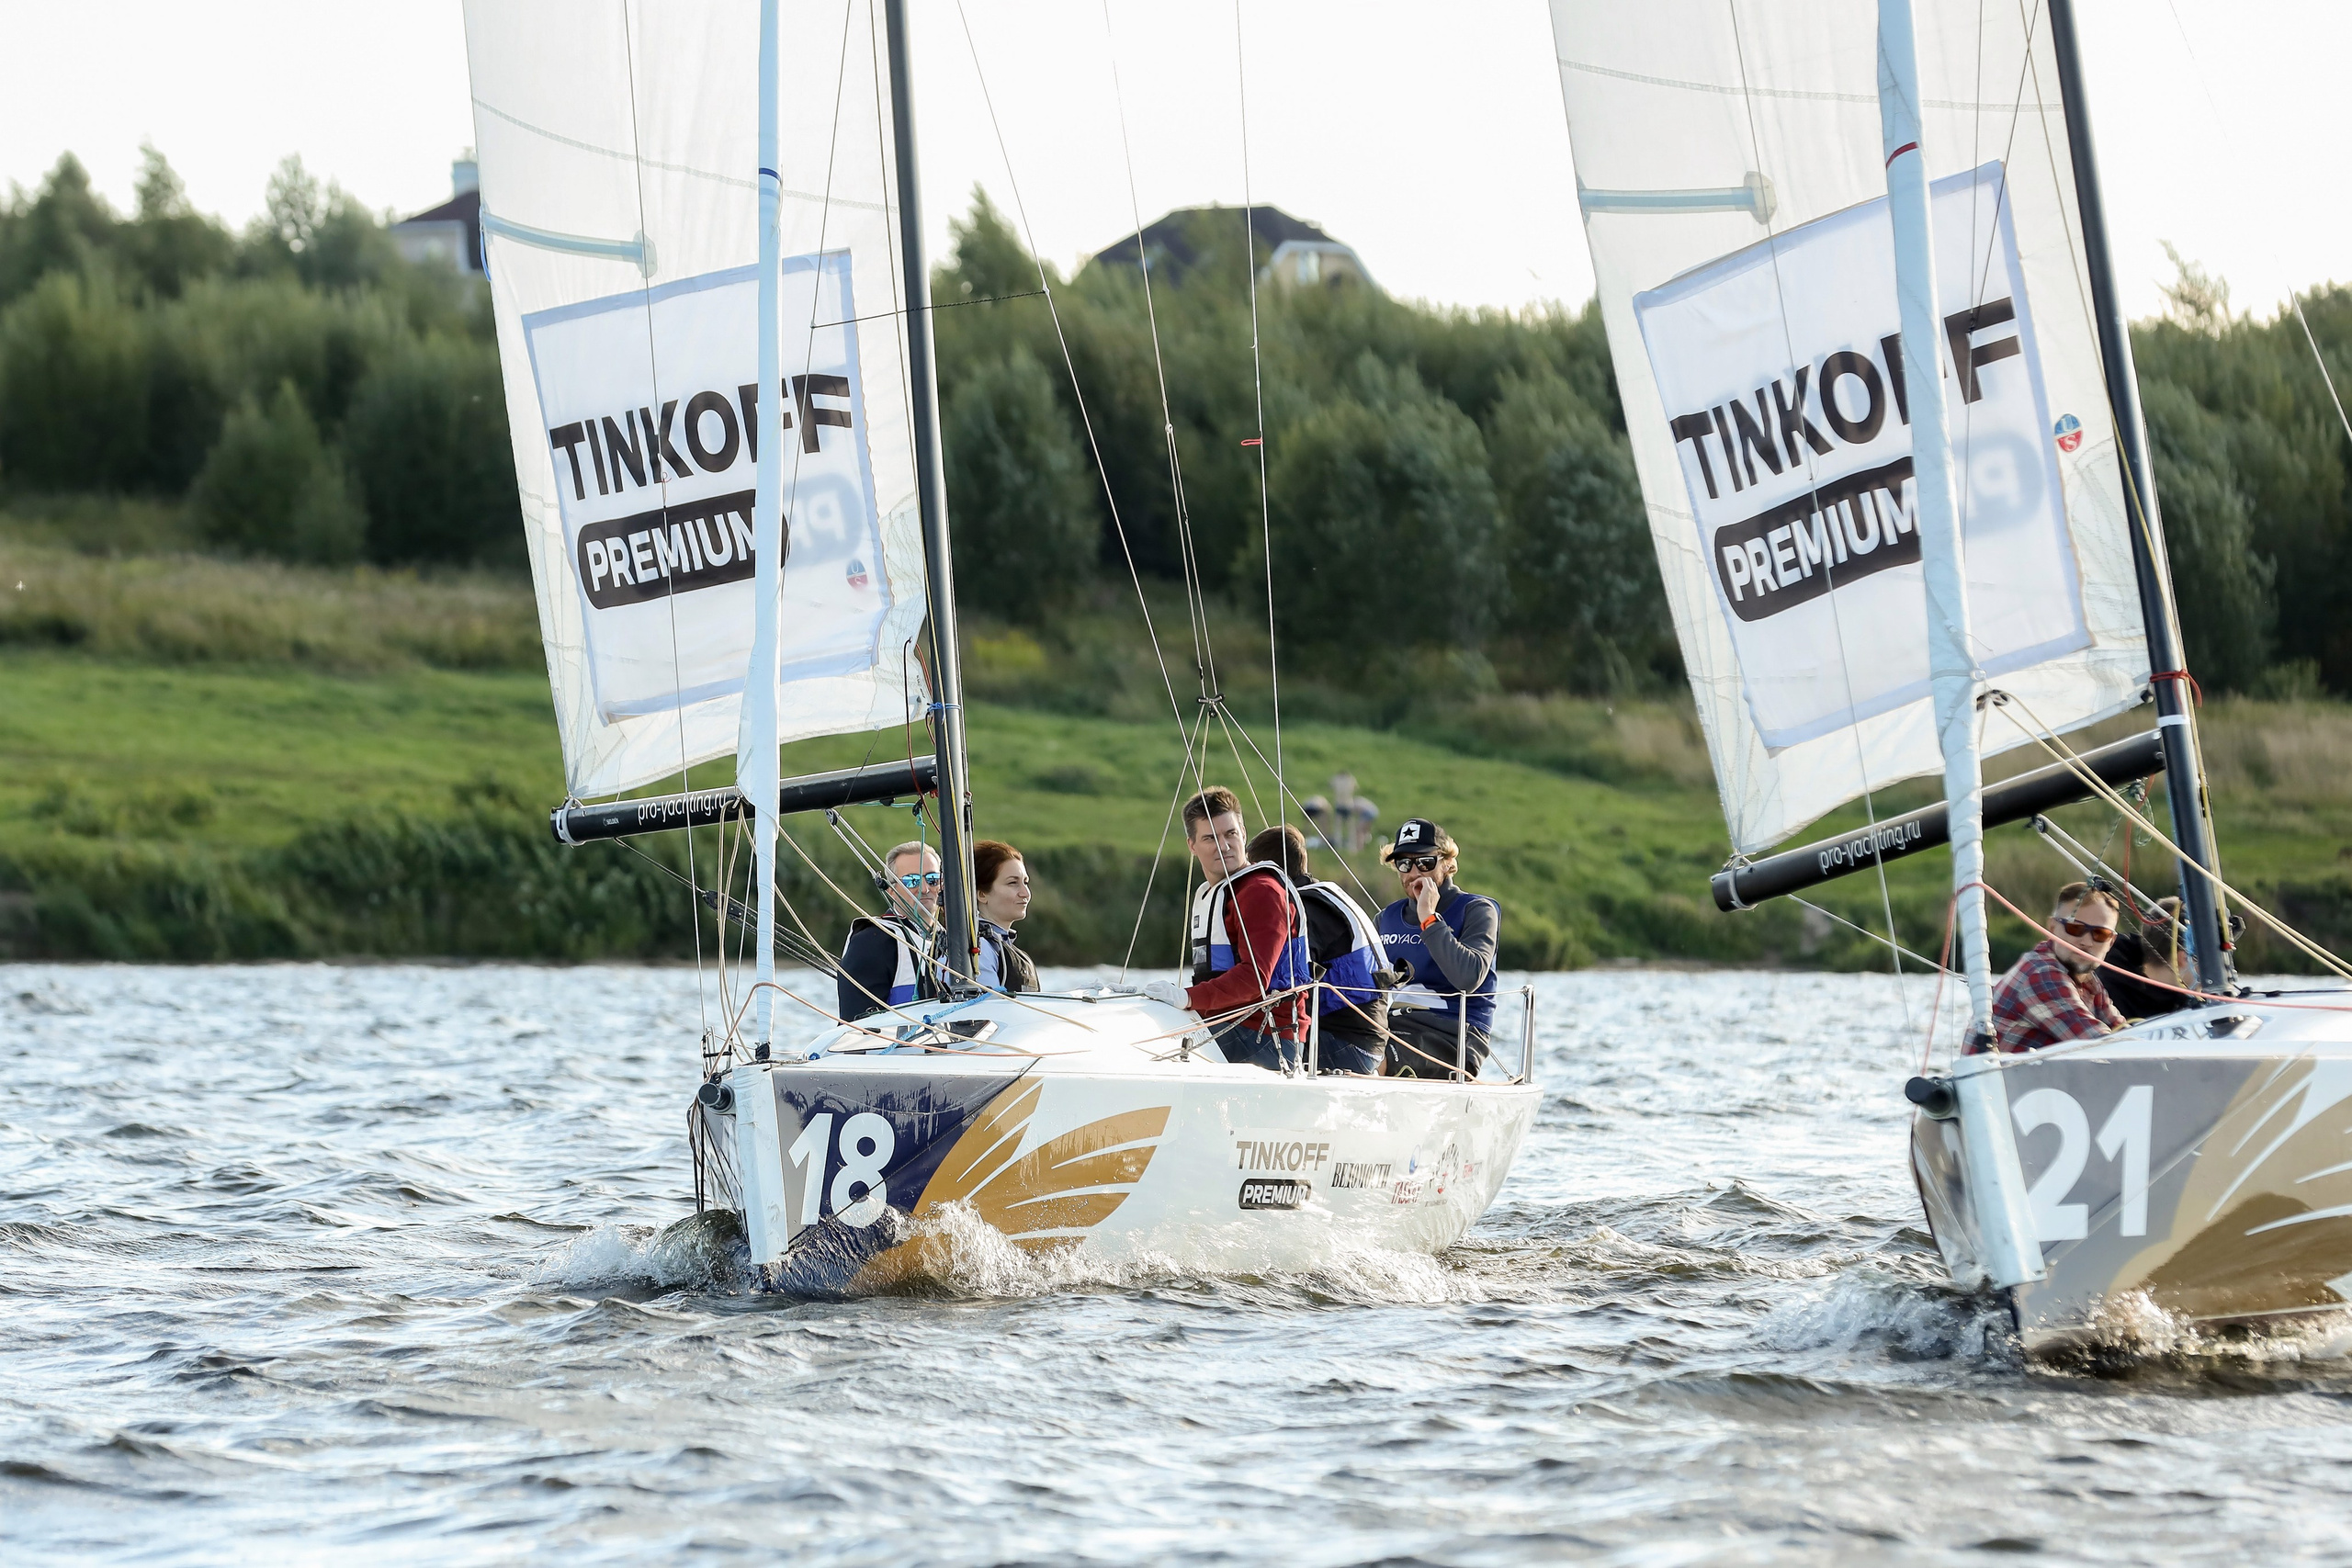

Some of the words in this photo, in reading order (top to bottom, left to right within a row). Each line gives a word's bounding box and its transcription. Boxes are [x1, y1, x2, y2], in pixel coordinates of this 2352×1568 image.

[1670, 297, 2021, 499] TINKOF
[638, 792, 727, 826] pro-yachting.ru
[1819, 820, 1922, 874] pro-yachting.ru
[788, 1112, 895, 1229] 18
[1236, 1141, 1330, 1171] TINKOFF
[2014, 1085, 2154, 1242] 21
[1242, 1184, 1308, 1204] PREMIUM
